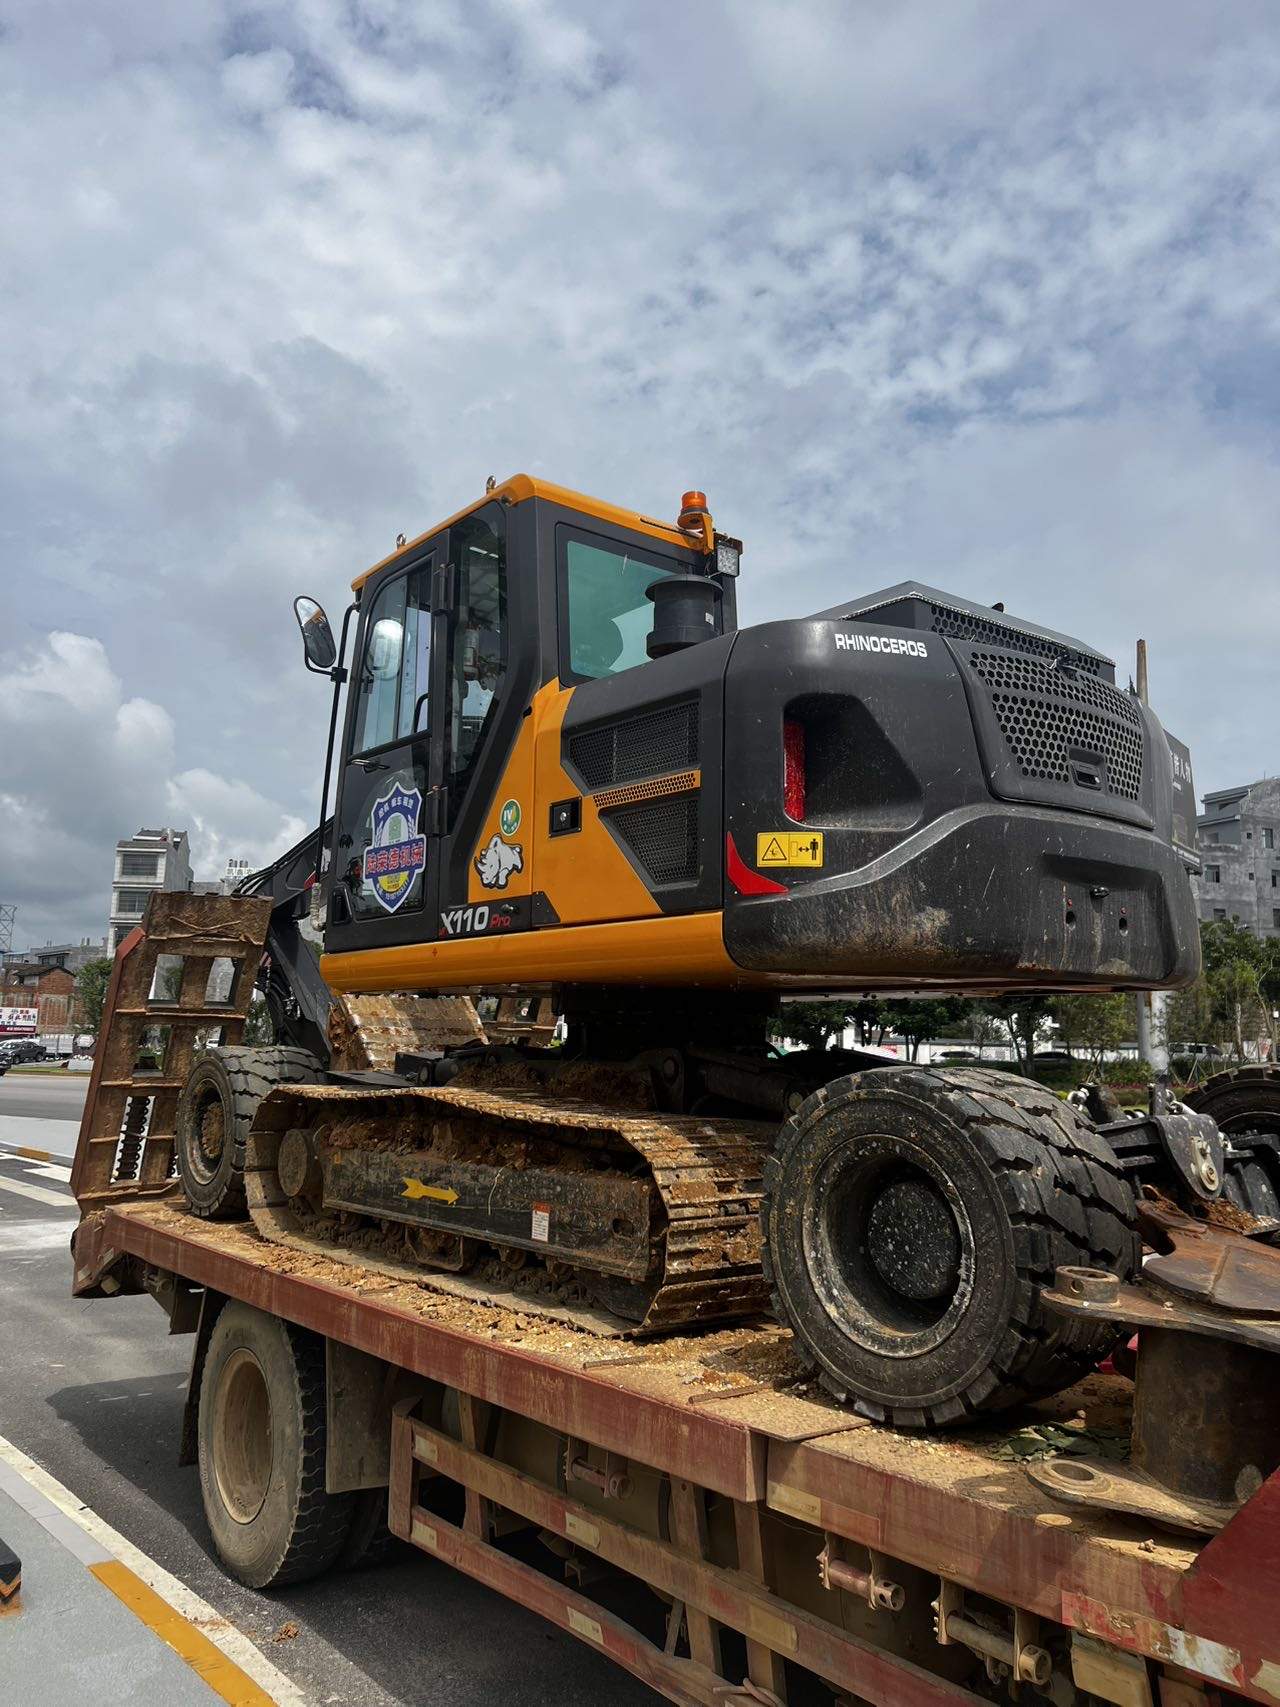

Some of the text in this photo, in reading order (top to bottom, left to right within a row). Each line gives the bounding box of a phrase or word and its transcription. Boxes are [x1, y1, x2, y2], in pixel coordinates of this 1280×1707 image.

[834, 633, 928, 658] RHINOCEROS
[440, 906, 489, 934] X110
[489, 914, 512, 929] Pro
